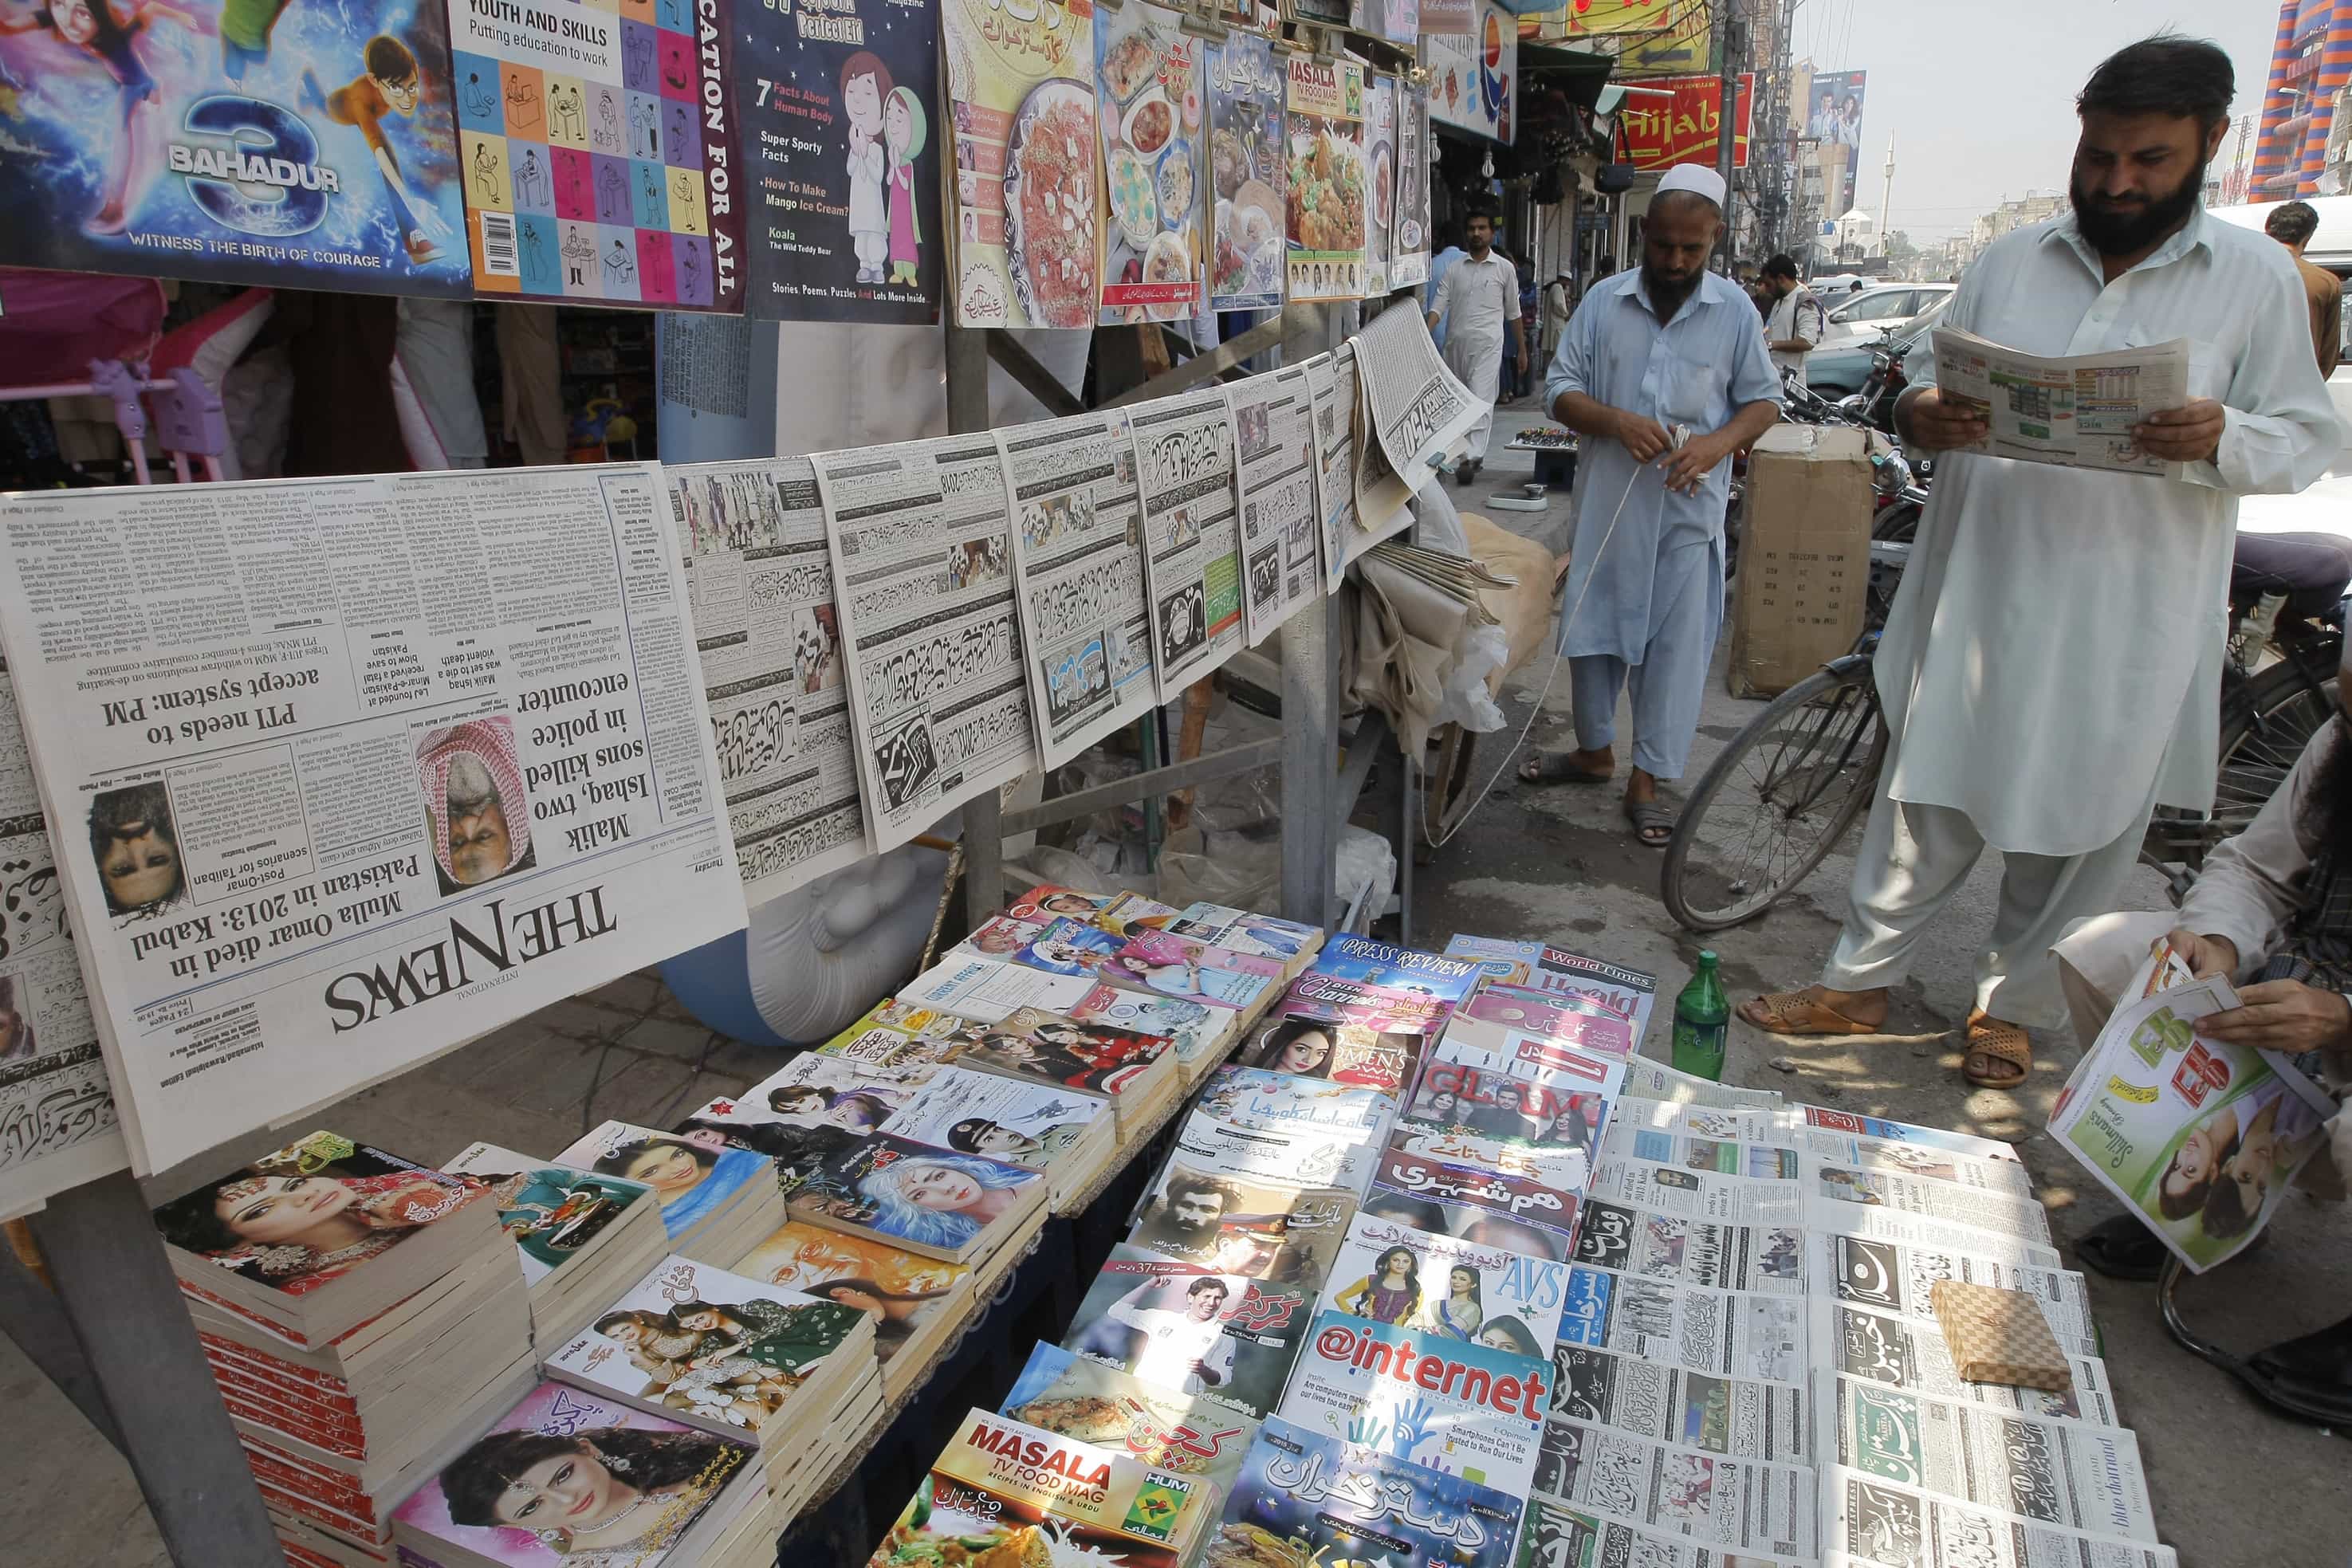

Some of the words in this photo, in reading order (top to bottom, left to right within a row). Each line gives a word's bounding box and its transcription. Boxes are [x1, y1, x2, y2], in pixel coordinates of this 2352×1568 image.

[525, 10, 557, 33] AND
[562, 19, 606, 45] SKILLS
[796, 10, 842, 41] Perfect
[840, 17, 867, 45] Eid
[470, 19, 509, 45] Putting
[513, 33, 567, 56] education
[570, 47, 580, 60] to
[583, 52, 607, 66] work
[756, 78, 771, 106] 7
[773, 82, 800, 98] Facts
[803, 90, 829, 106] About
[1296, 83, 1304, 94] TV
[1305, 84, 1322, 97] FOOD
[1323, 88, 1337, 100] MAG
[774, 100, 808, 116] Human
[810, 108, 832, 124] Body
[1619, 99, 1719, 144] Hijab
[761, 131, 789, 146] Super
[792, 137, 822, 155] Sporty
[762, 147, 789, 163] Facts
[168, 144, 340, 195] BAHADUR
[707, 143, 732, 217] FOR
[765, 177, 786, 190] How
[789, 181, 800, 193] To
[802, 183, 826, 197] Make
[765, 194, 796, 210] Mango
[800, 199, 813, 211] Ice
[816, 202, 848, 216] Cream?
[769, 226, 795, 240] Koala
[128, 230, 205, 255] WITNESS
[209, 239, 238, 258] THE
[242, 242, 287, 262] BIRTH
[290, 247, 309, 263] OF
[313, 250, 382, 269] COURAGE
[713, 228, 736, 296] ALL
[769, 241, 781, 250] The
[782, 242, 796, 251] Wild
[797, 244, 816, 255] Teddy
[817, 246, 831, 255] Bear
[831, 286, 856, 298] Puzzles
[873, 290, 887, 300] Lots
[887, 291, 905, 301] More
[254, 654, 277, 665] MQM
[305, 646, 328, 654] Urges
[147, 666, 198, 679] resolutions
[201, 659, 242, 670] withdraw
[77, 676, 129, 690] de-seating
[152, 679, 242, 709] system:
[248, 670, 318, 697] accept
[517, 674, 627, 712] encounter
[102, 698, 146, 726] PM
[255, 703, 296, 729] PTI
[604, 709, 626, 733] in
[147, 725, 174, 745] to
[180, 712, 248, 741] needs
[533, 709, 598, 747] police
[596, 740, 643, 766] sons
[525, 754, 589, 792] killed
[582, 774, 647, 804] Ishaq,
[534, 794, 576, 819] two
[357, 841, 381, 852] Afghan
[381, 836, 398, 845] deny
[399, 830, 423, 841] Taliban
[565, 813, 632, 854] Malik
[257, 847, 307, 867] scenarios
[320, 852, 344, 863] claim
[342, 847, 356, 858] govt
[693, 858, 725, 874] Thursday
[194, 868, 236, 885] Taliban
[227, 868, 284, 890] Post-Omar
[238, 862, 254, 874] for
[324, 855, 419, 894] Pakistan
[293, 885, 317, 906] in
[337, 891, 401, 925] Mulla
[221, 894, 288, 930] 2013:
[513, 885, 618, 963] THE
[132, 916, 213, 960] Kabul
[269, 914, 332, 946] Omar
[170, 955, 198, 977] in
[205, 937, 260, 972] died
[324, 898, 517, 1034] NEWS
[1342, 938, 1397, 961] PRESS
[1398, 949, 1475, 977] REVIEW
[1549, 951, 1599, 973] World
[1603, 967, 1650, 986] Times
[457, 969, 520, 1001] INTERNATIONAL
[1299, 973, 1381, 1008] Channels
[1331, 981, 1363, 993] DISH
[160, 1072, 184, 1087] Edition
[1352, 1063, 1402, 1079] OWN
[2089, 1111, 2133, 1169] Stillman's
[1500, 1253, 1563, 1308] AVS
[1316, 1325, 1545, 1422] @internet
[1304, 1381, 1315, 1389] Are
[1315, 1385, 1347, 1399] computers
[1349, 1394, 1371, 1409] making
[1311, 1393, 1327, 1403] lives
[1327, 1397, 1337, 1406] too
[1445, 1432, 1469, 1447] Trusted
[1478, 1443, 1492, 1454] Run
[1493, 1448, 1505, 1458] Our
[1506, 1452, 1523, 1464] Lives
[1452, 1425, 1496, 1444] Smartphones
[1496, 1438, 1516, 1451] Can't
[1516, 1444, 1525, 1454] Be
[1493, 1427, 1531, 1442] E-Opinion
[969, 1425, 1109, 1489] MASALA
[2096, 1437, 2122, 1495] diamond
[988, 1472, 1018, 1485] RECIPES
[1032, 1487, 1066, 1502] ENGLISH
[1076, 1501, 1099, 1512] URDU
[993, 1457, 1013, 1472] TV
[1013, 1465, 1060, 1487] FOOD
[1064, 1480, 1104, 1503] MAG
[1145, 1472, 1190, 1492] HUM
[1268, 1445, 1494, 1546] دسترخوان
[1846, 1482, 1859, 1524] EXPRESS
[2110, 1498, 2129, 1527] blue
